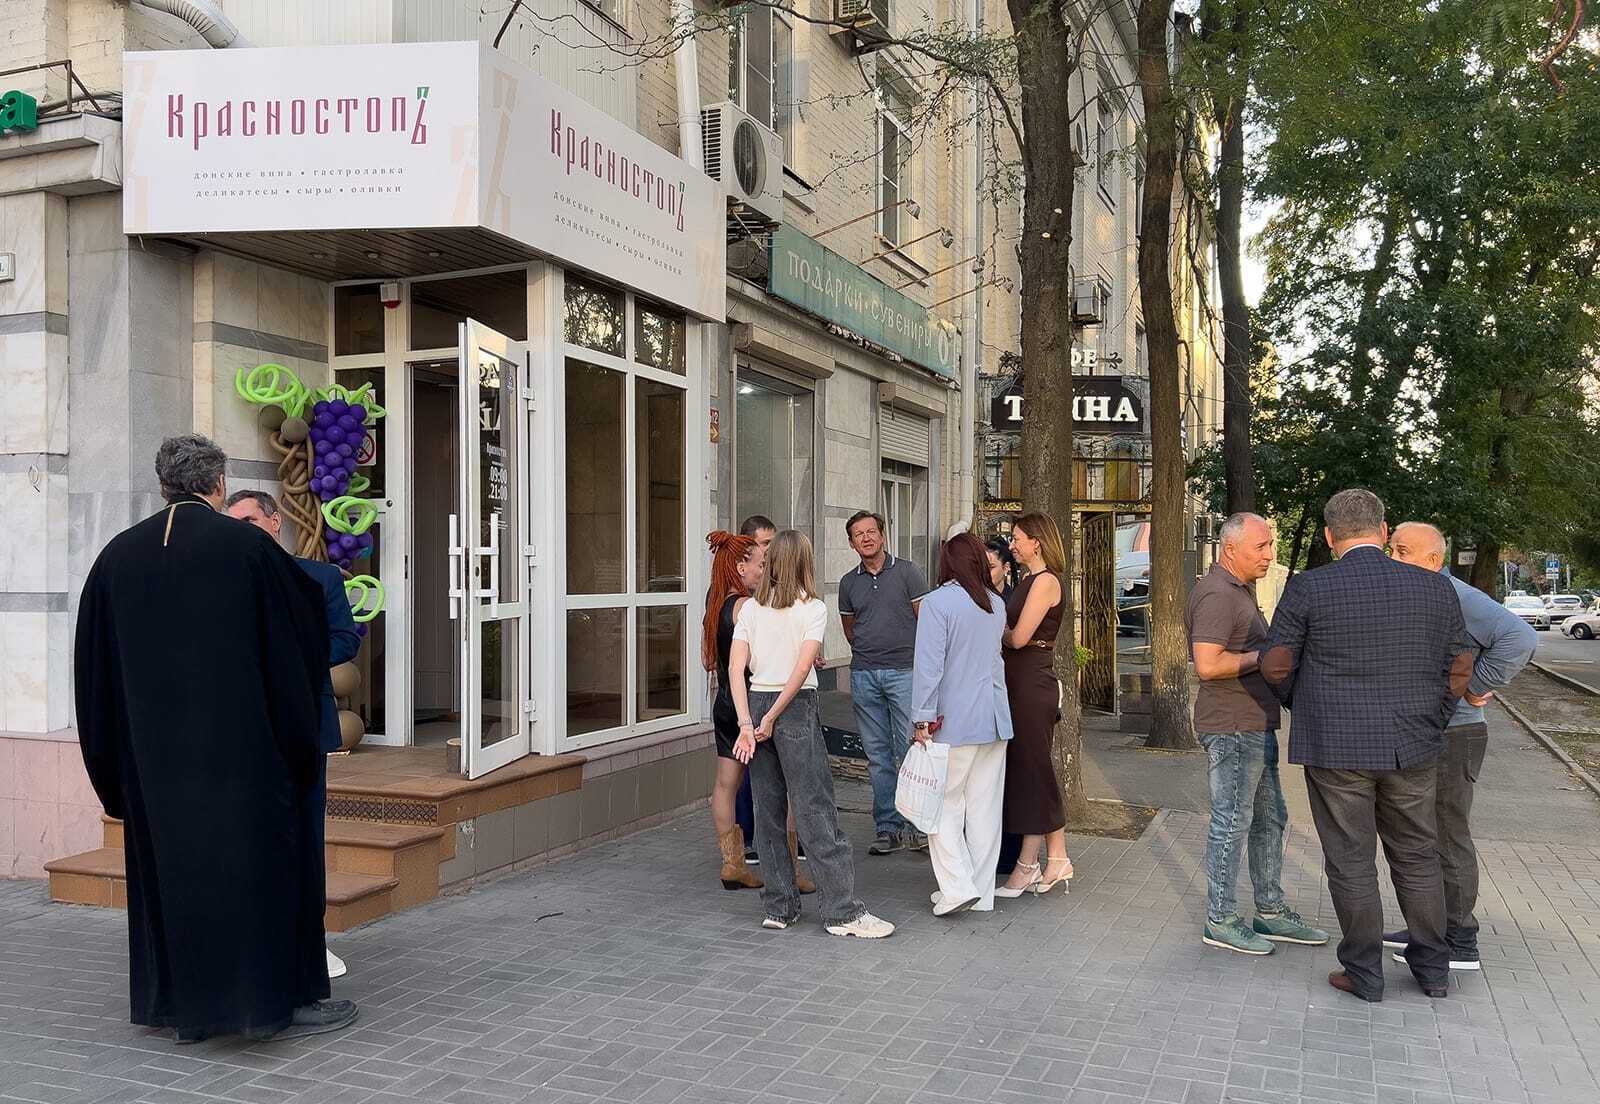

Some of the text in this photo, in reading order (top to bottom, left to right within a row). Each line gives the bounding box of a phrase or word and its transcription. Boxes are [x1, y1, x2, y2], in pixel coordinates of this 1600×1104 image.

[194, 166, 405, 182] донские вина гастролавка
[196, 184, 402, 199] деликатесы сыры оливки
[553, 191, 594, 215] донские
[599, 212, 622, 228] вина
[554, 214, 612, 245] деликатесы
[622, 243, 645, 259] сыры
[788, 251, 932, 348] ПОДАРКИ СУВЕНИРЫ
